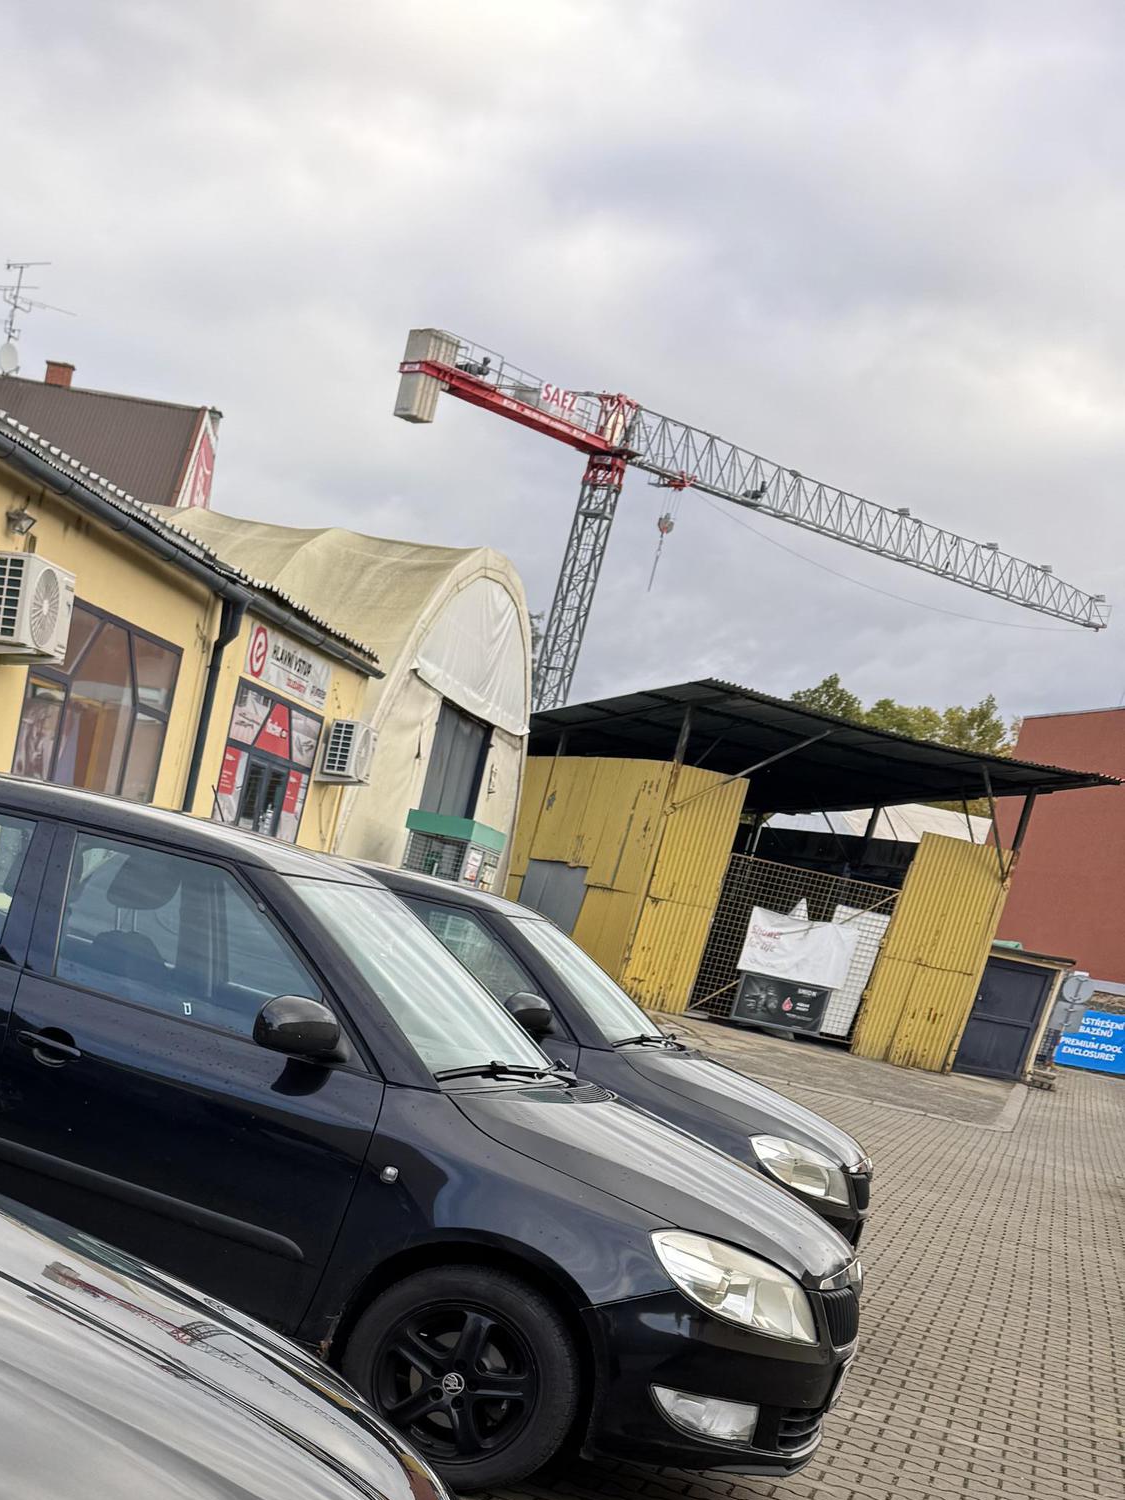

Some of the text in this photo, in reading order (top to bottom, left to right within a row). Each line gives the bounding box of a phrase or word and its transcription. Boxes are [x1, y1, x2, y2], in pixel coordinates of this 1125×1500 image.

[542, 383, 577, 412] SAEZ
[1060, 1036, 1123, 1054] PREMIUM POOL
[1061, 1045, 1116, 1062] ENCLOSURES
